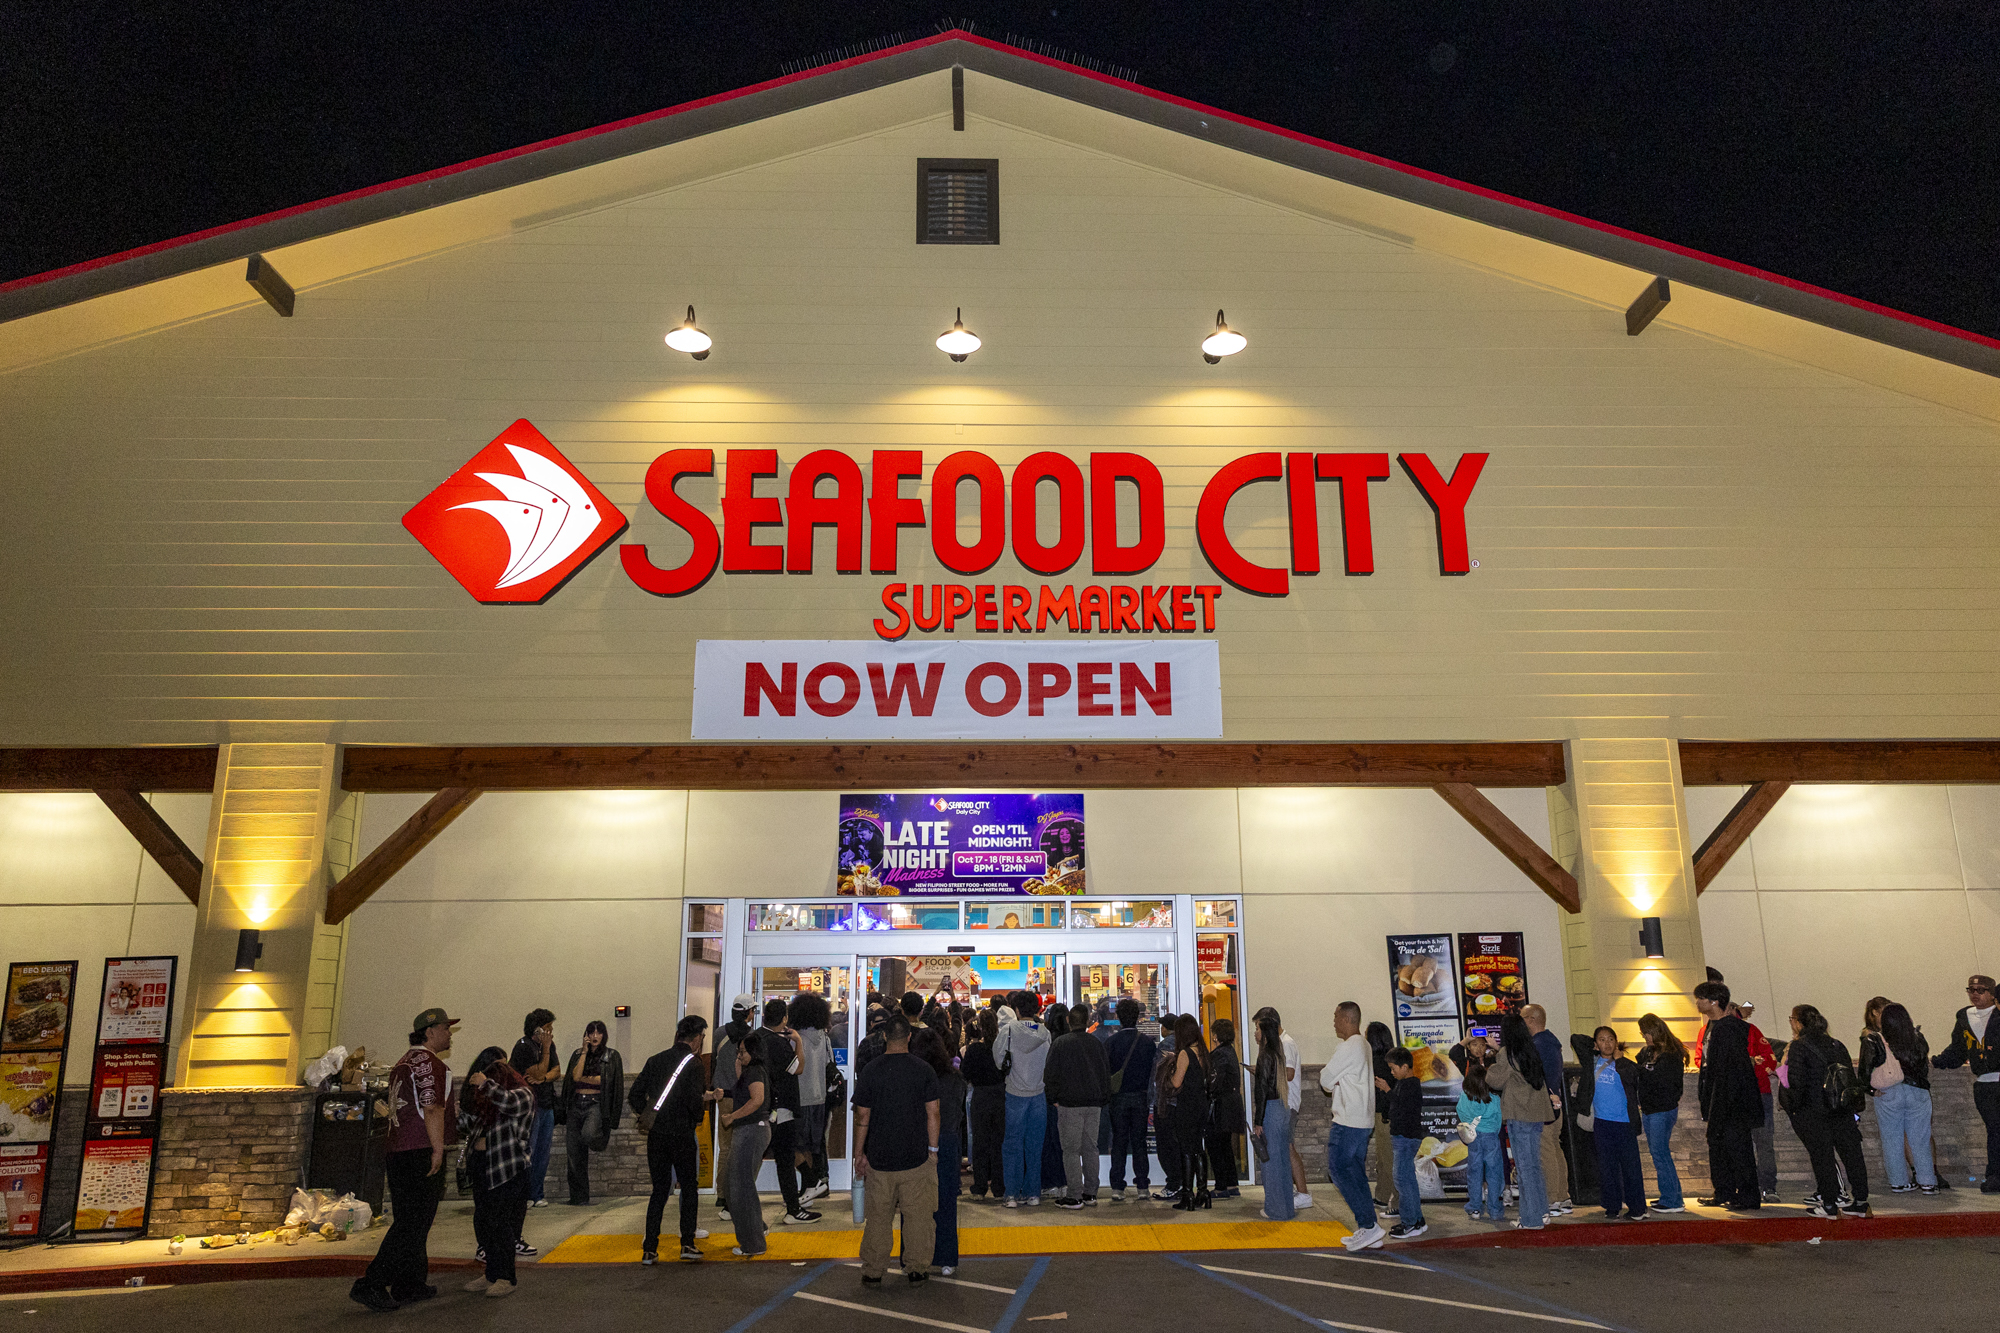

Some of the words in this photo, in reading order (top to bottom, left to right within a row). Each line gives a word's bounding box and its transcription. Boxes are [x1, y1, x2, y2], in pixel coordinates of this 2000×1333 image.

[620, 448, 1165, 597] SEAFOOD
[1196, 451, 1490, 597] CITY
[873, 582, 1222, 641] SUPERMARKET
[743, 661, 946, 717] NOW
[965, 661, 1173, 717] OPEN
[947, 801, 974, 810] SEAFOOD
[974, 801, 990, 810] CITY
[883, 821, 950, 846] LATE
[972, 825, 1005, 835] OPEN
[968, 837, 1032, 848] MIDNIGHT!
[882, 848, 950, 869] NIGHT
[957, 855, 973, 864] Oct
[975, 855, 983, 864] 17
[989, 855, 998, 864] 18
[999, 855, 1014, 865] (FRI
[1016, 855, 1023, 864] &
[1024, 855, 1042, 865] SAT)
[973, 864, 993, 872] 8PM
[1001, 864, 1026, 872] 12MN
[883, 864, 945, 885] Madness
[752, 905, 811, 930] 1420
[1398, 946, 1416, 955] Pan
[1416, 945, 1426, 954] de
[1427, 945, 1444, 954] Sal!
[925, 958, 951, 966] FOOD
[1468, 962, 1497, 971] served
[41, 965, 72, 973] DELIGHT
[814, 976, 821, 986] 3
[1093, 973, 1101, 983] 5
[1126, 973, 1134, 983] 6
[45, 992, 52, 1000] 4
[1404, 1029, 1444, 1038] Empanada
[1421, 1036, 1455, 1046] Squares!
